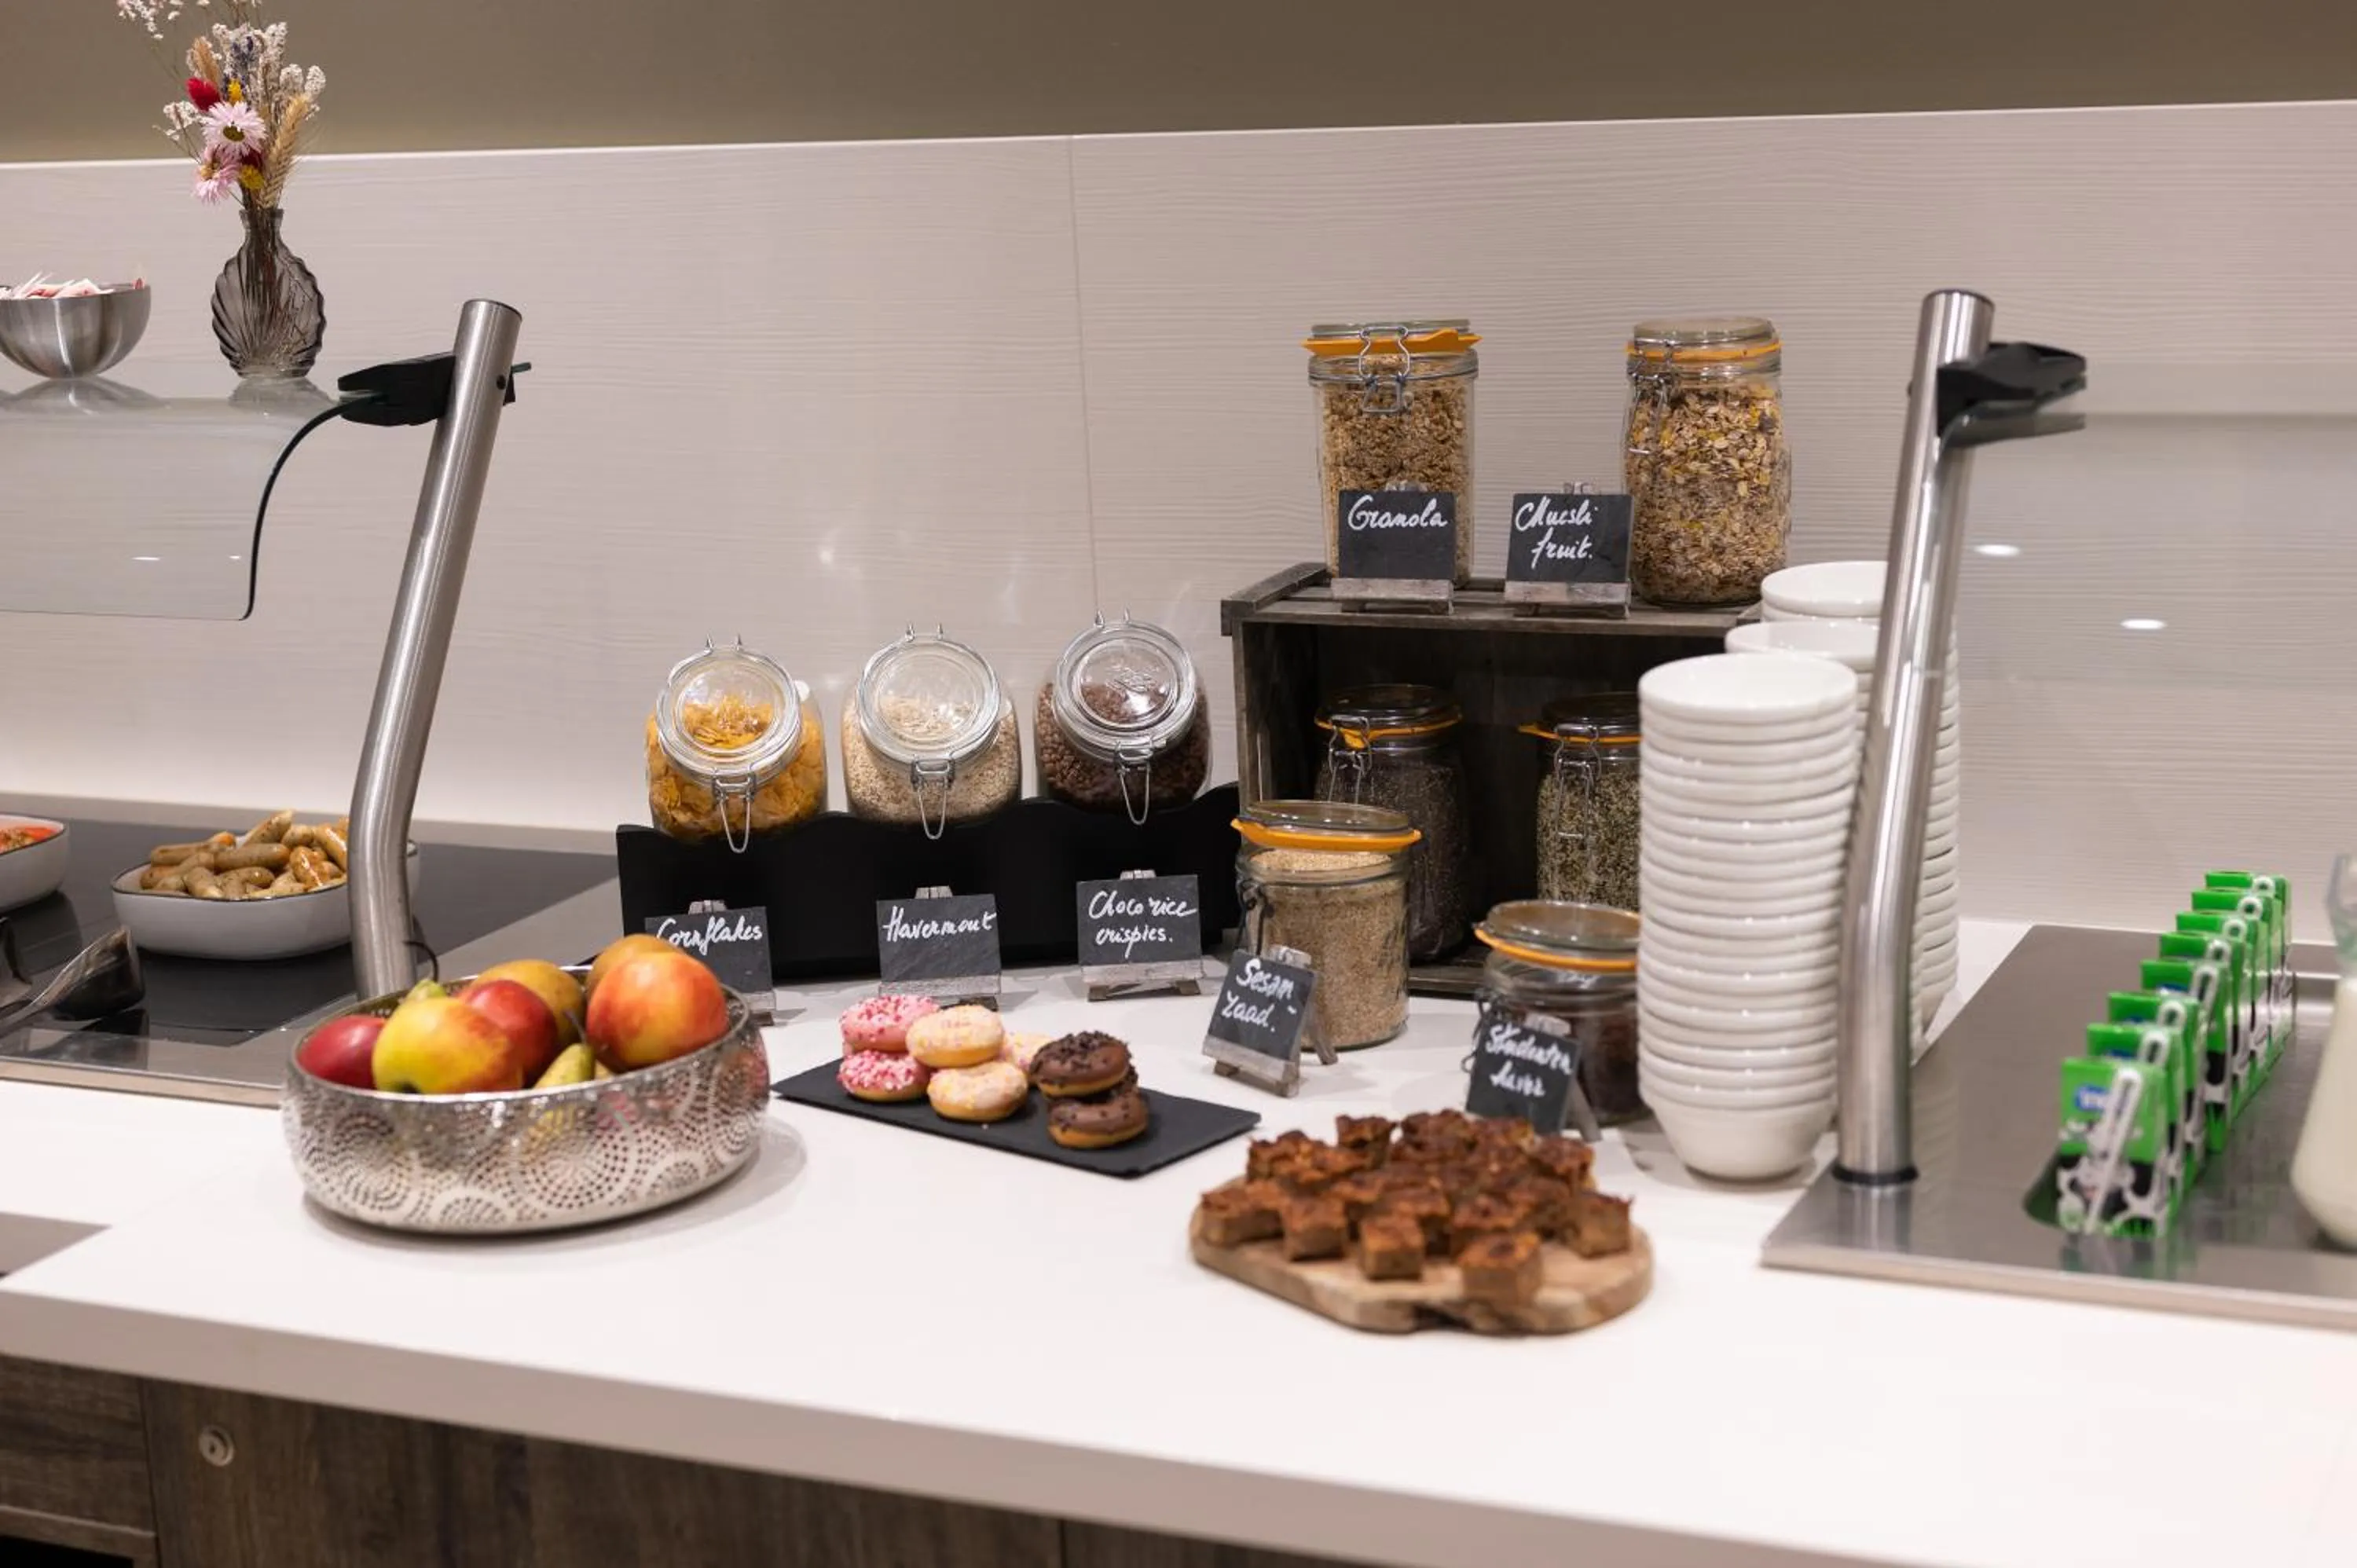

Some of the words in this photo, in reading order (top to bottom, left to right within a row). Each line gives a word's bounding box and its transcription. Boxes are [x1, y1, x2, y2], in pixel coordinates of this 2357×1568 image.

[1347, 495, 1448, 531] Granola
[1088, 890, 1144, 920] Choco
[1148, 897, 1198, 918] rice
[882, 905, 997, 943] Havermout
